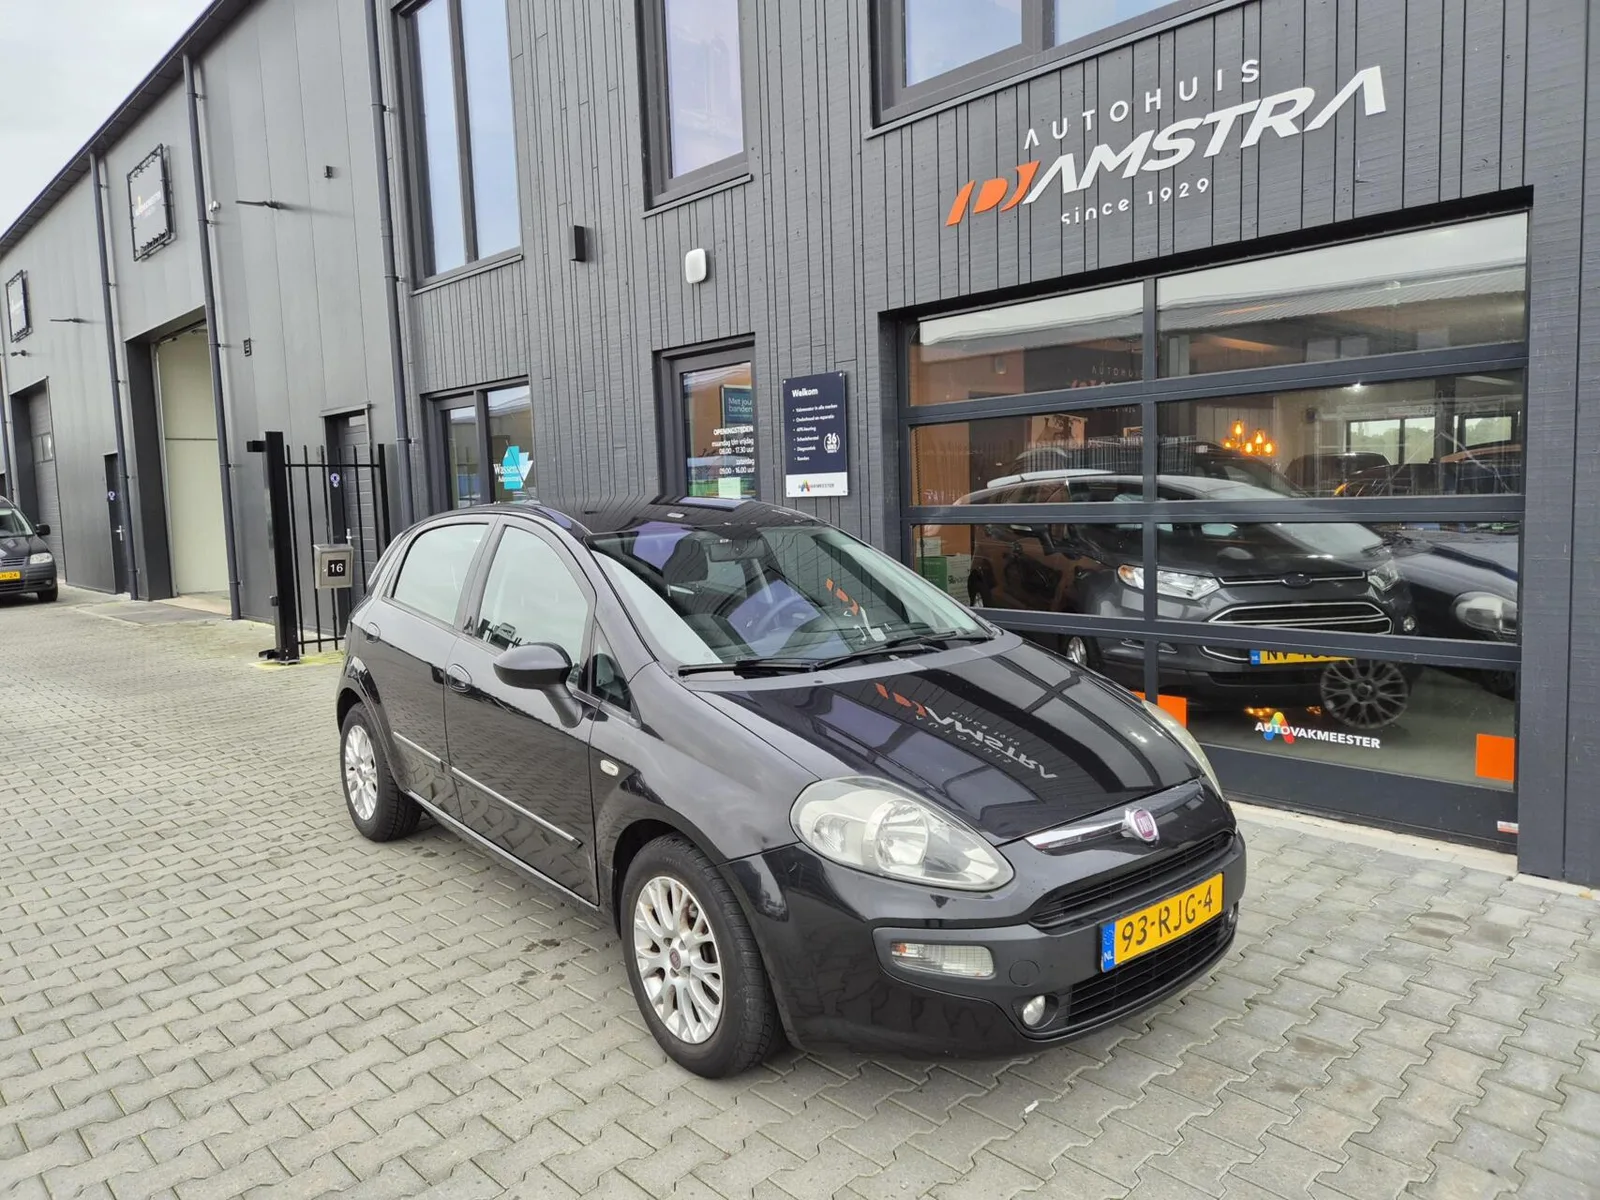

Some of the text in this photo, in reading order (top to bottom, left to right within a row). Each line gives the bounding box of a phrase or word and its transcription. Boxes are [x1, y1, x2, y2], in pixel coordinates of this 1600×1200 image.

[1023, 59, 1260, 150] AUTOHUIS
[1061, 177, 1210, 225] since 1929
[791, 387, 819, 397] Welkom
[826, 432, 838, 444] 36
[330, 563, 344, 573] 16
[1255, 721, 1381, 749] AUTOVAKMEESTER
[1121, 884, 1213, 953] 93-RJG-4
[1103, 951, 1114, 962] NL
